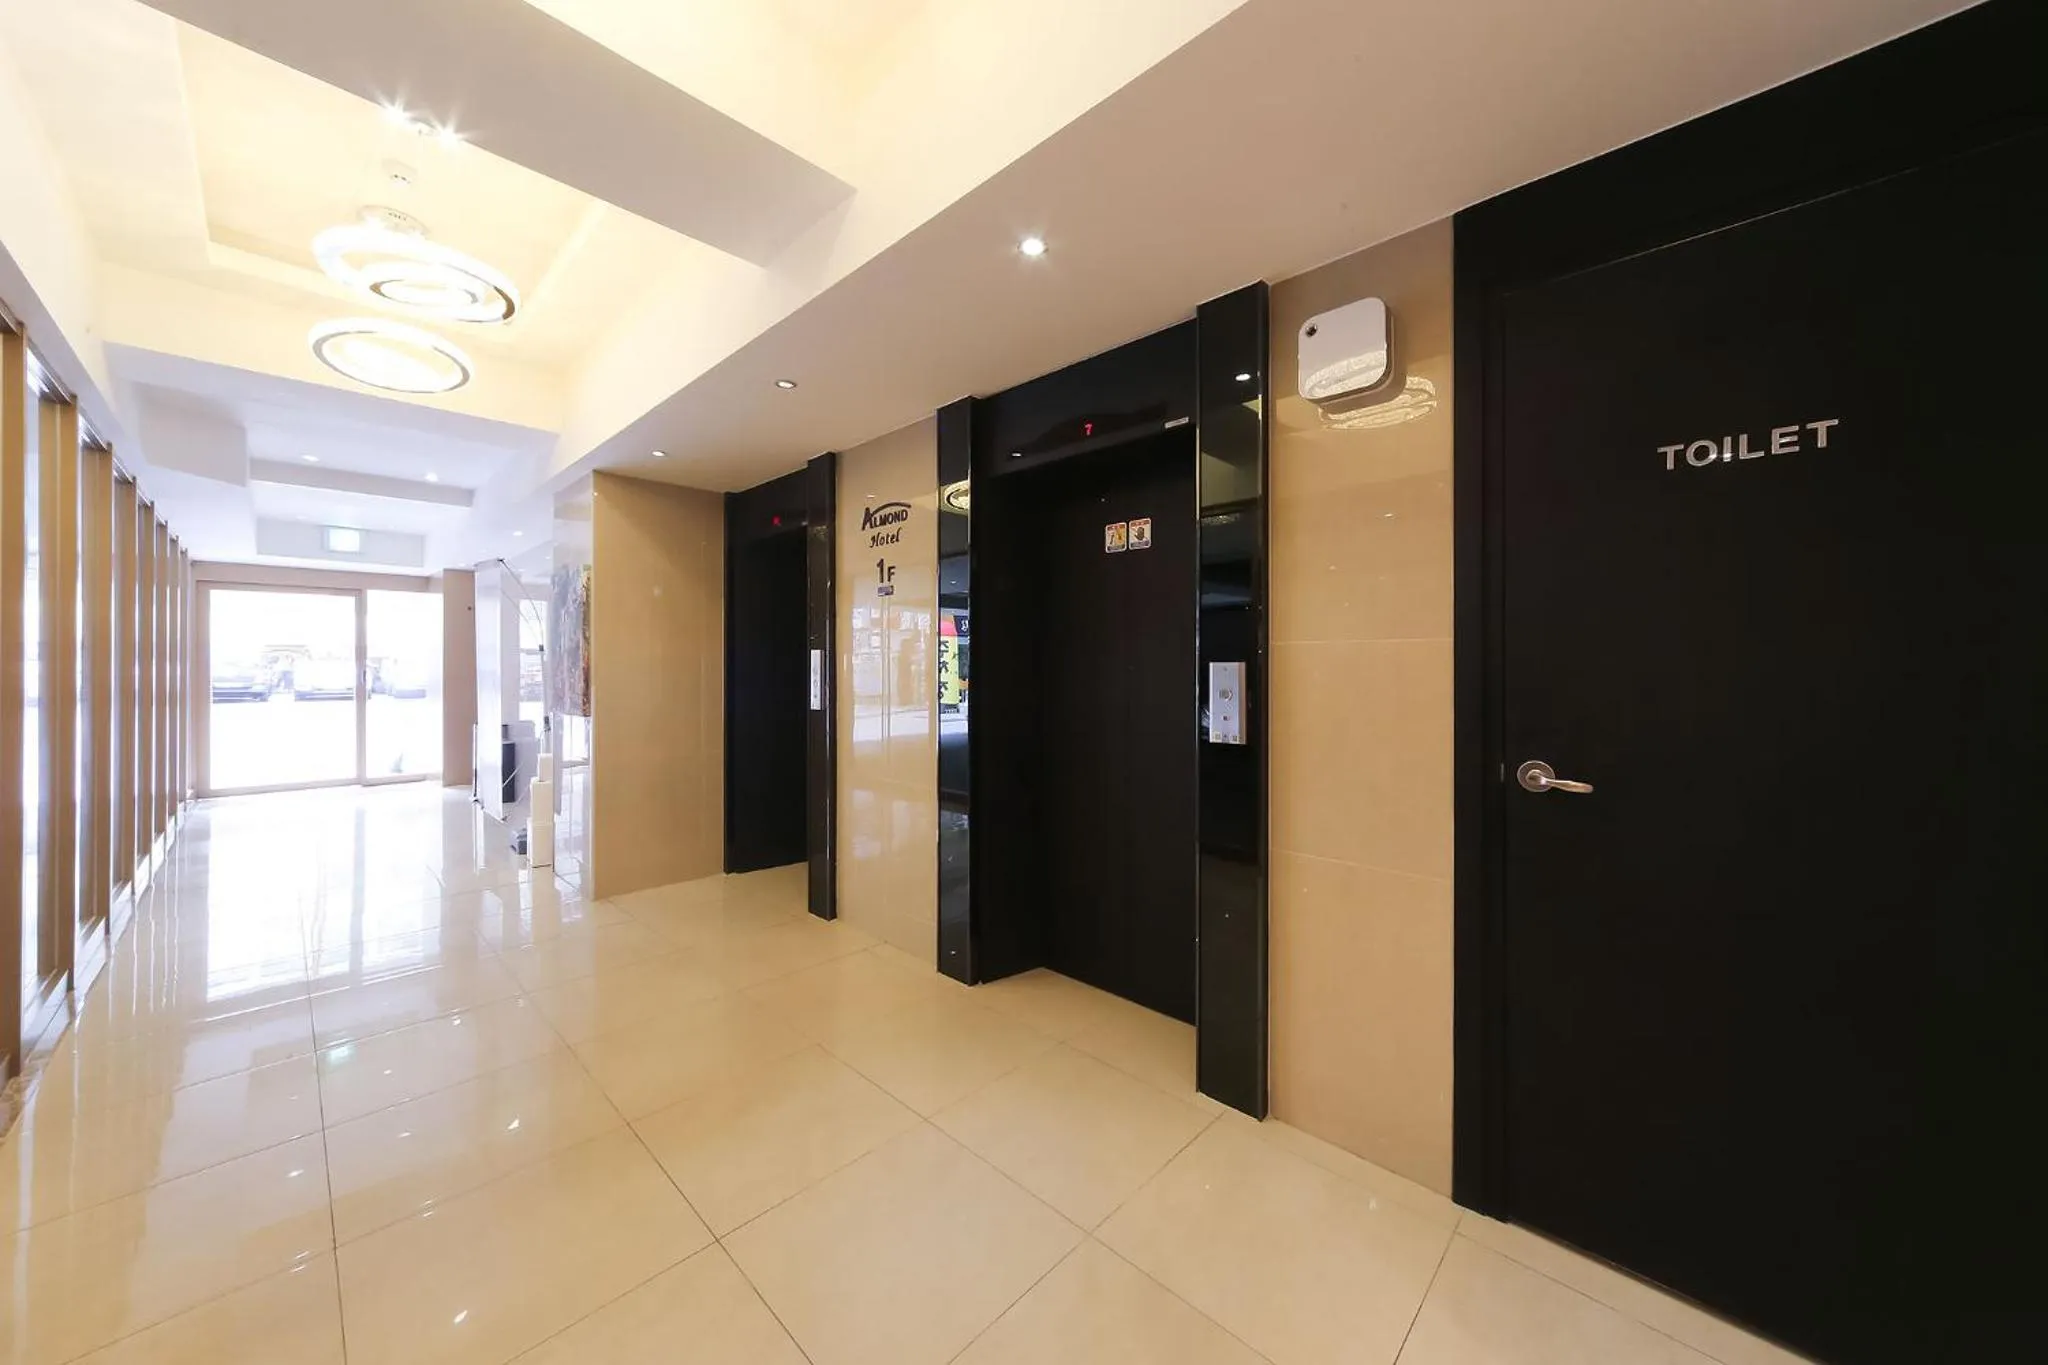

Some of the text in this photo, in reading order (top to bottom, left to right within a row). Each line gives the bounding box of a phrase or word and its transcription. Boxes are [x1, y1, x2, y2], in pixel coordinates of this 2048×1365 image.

[1084, 423, 1093, 436] 7
[1657, 418, 1839, 470] TOILET
[861, 504, 909, 531] ALMOND
[869, 527, 902, 548] Hotel
